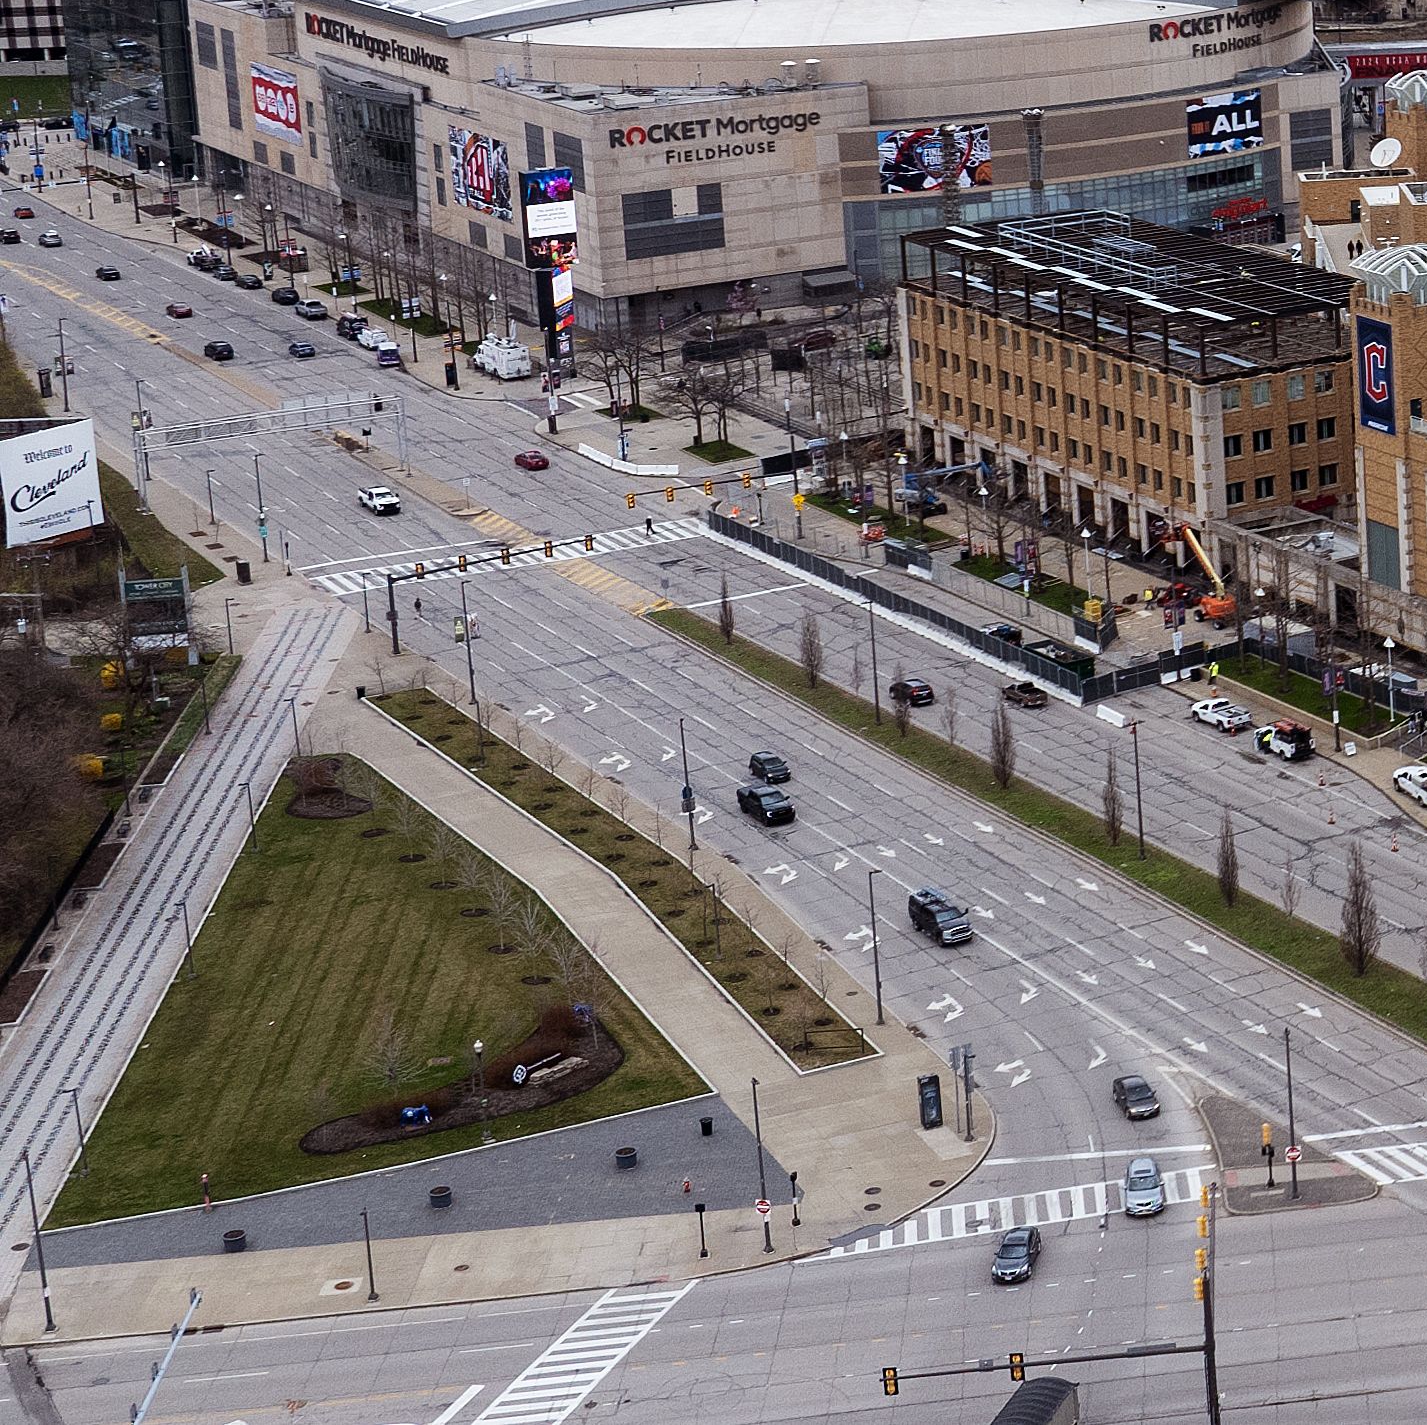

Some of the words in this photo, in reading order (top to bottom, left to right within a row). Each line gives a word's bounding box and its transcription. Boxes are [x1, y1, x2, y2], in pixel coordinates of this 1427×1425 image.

[304, 12, 345, 44] ROCKET
[345, 24, 391, 62] Mortgage
[1149, 13, 1224, 43] ROCKET
[1227, 4, 1282, 30] Mortgage
[609, 119, 711, 148] ROCKET
[716, 111, 821, 136] Mortgage
[1211, 109, 1260, 136] ALL
[1364, 341, 1389, 403] C
[10, 450, 91, 513] Cleveland
